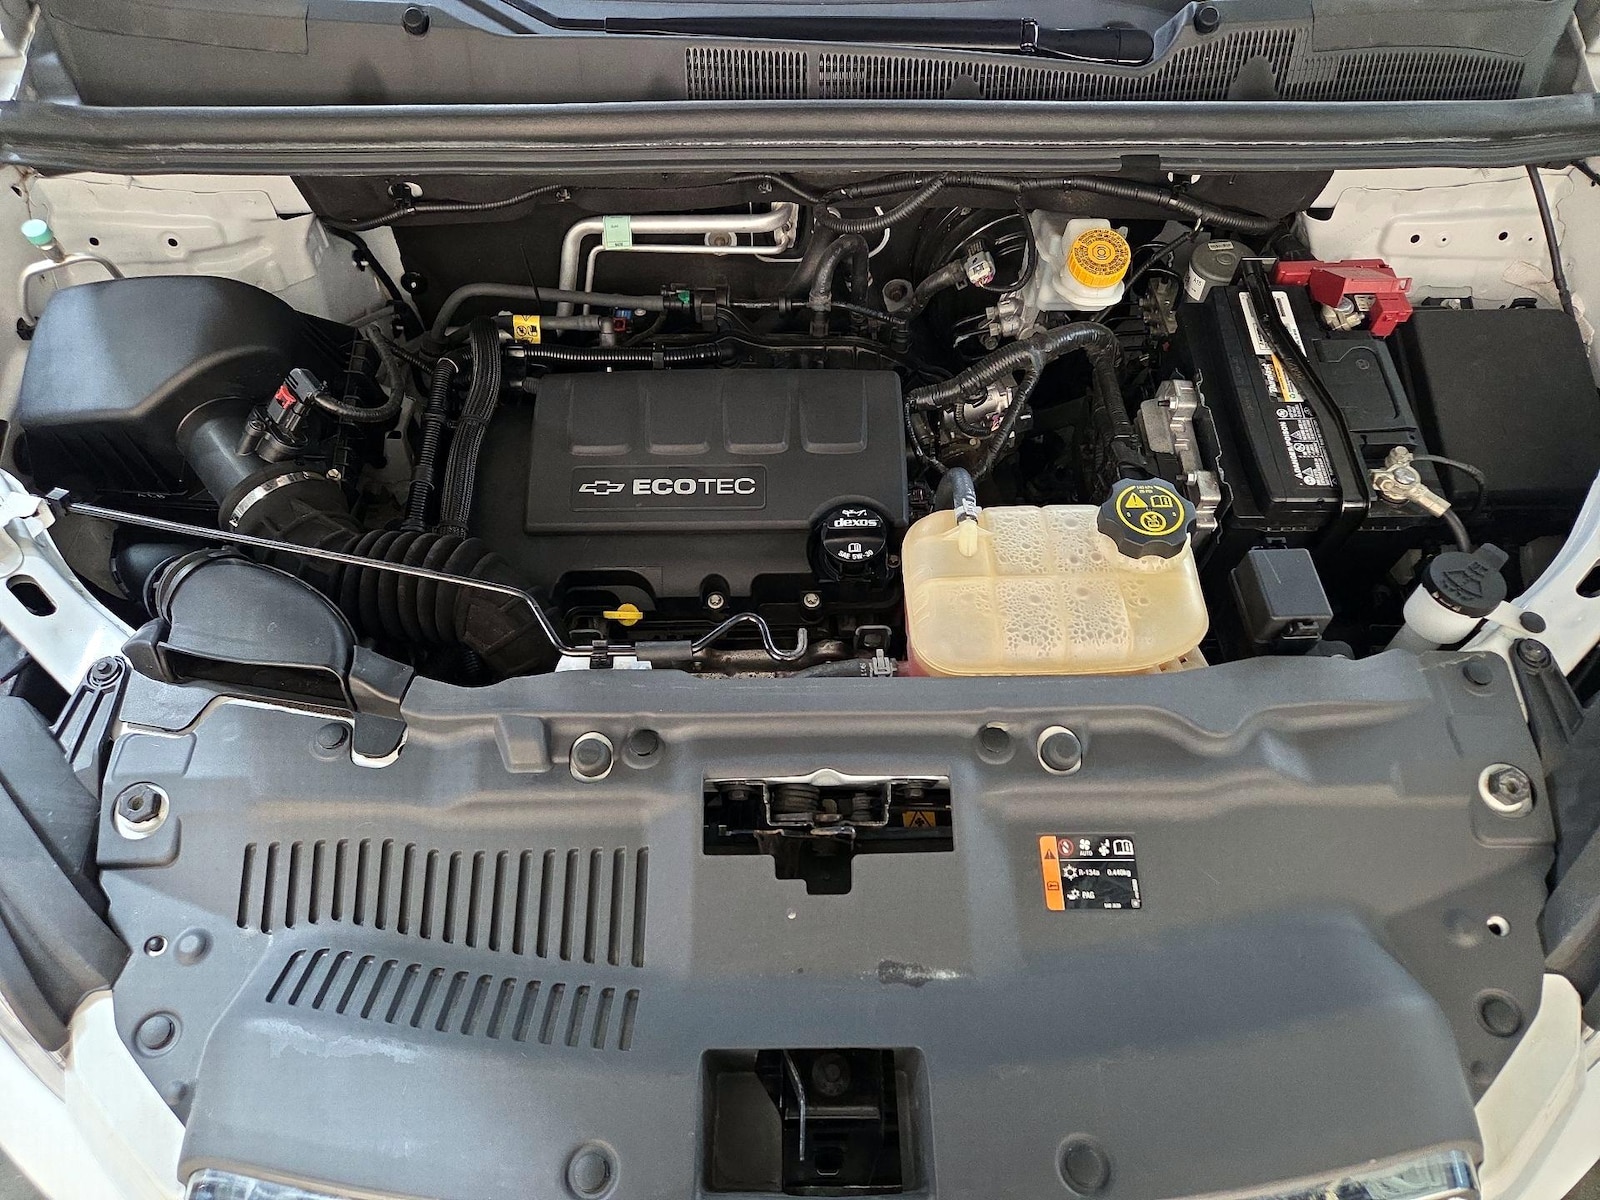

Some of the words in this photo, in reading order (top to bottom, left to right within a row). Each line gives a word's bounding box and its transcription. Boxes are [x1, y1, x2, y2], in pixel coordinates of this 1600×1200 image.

[632, 477, 756, 496] ECOTEC
[834, 517, 879, 528] dexos
[838, 550, 851, 560] SAE
[851, 549, 874, 560] 5W-30
